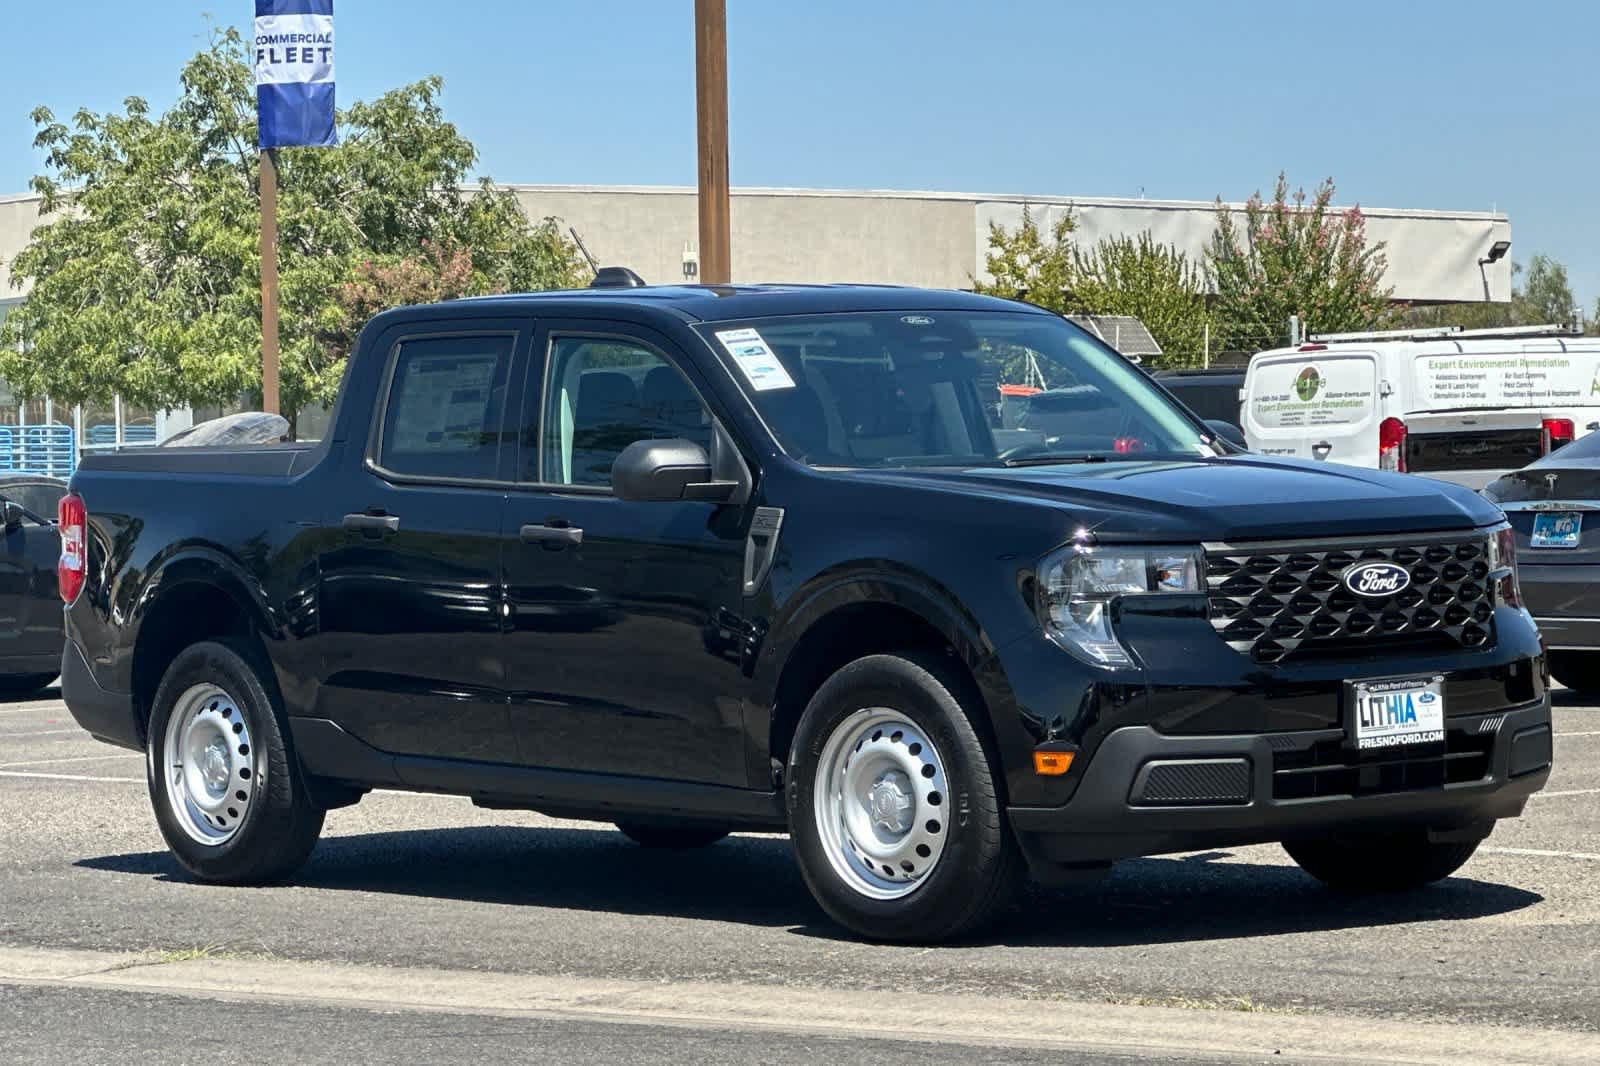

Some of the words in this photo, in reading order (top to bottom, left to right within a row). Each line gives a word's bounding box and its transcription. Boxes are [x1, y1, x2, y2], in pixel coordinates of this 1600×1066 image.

[255, 32, 332, 46] COMMERCIAL
[256, 47, 332, 65] FLEET
[1428, 359, 1456, 370] Expert
[1458, 359, 1518, 369] Environmental
[1520, 358, 1570, 368] Remediation
[1359, 568, 1399, 592] Ford
[1359, 692, 1417, 728] LITHIA
[1358, 731, 1445, 749] FRESNOFORD.COM
